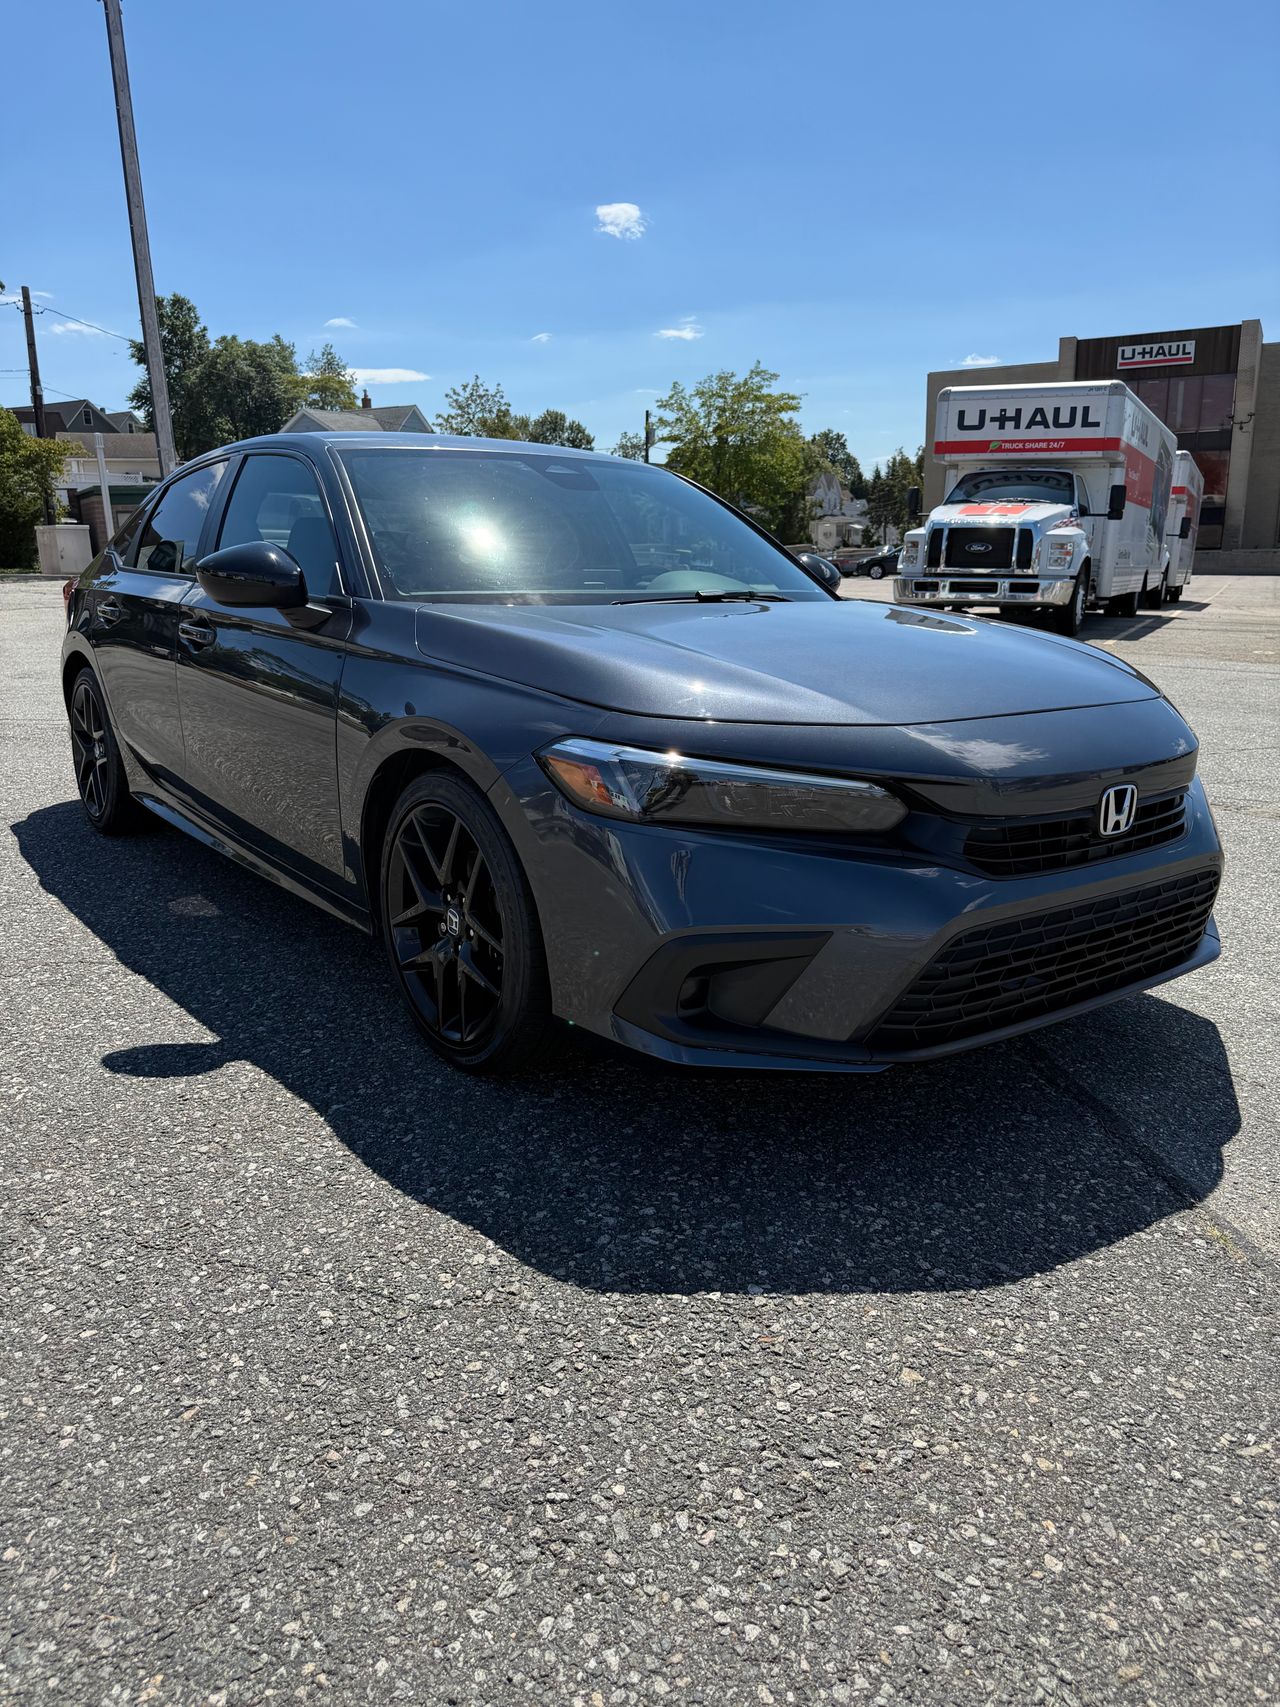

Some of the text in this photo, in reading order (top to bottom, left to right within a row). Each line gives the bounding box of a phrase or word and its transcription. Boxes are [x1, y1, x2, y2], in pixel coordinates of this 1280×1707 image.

[1121, 343, 1191, 361] U-HAUL
[957, 406, 1100, 431] U-HAUL
[1001, 442, 1024, 450] TRUCK
[1049, 441, 1065, 449] 24/7
